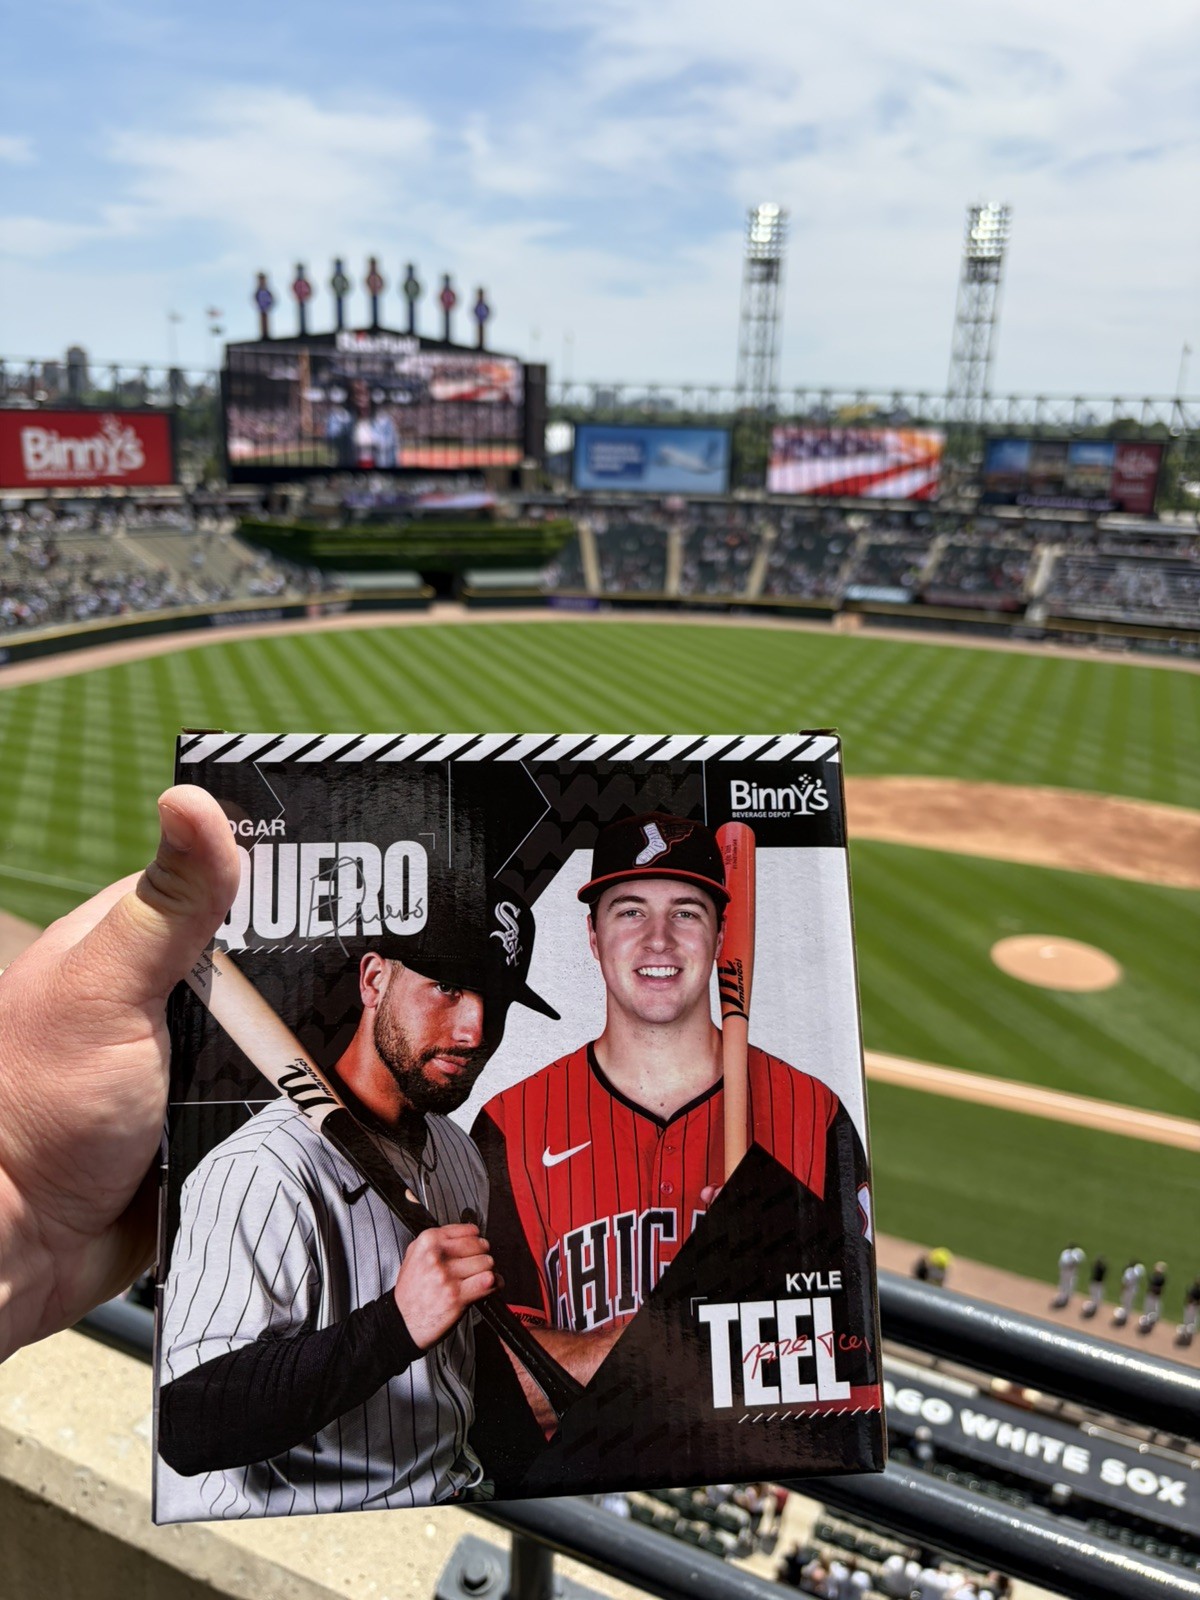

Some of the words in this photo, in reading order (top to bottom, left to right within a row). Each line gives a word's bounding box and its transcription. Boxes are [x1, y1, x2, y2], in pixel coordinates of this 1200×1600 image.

[226, 819, 286, 836] DGAR
[213, 840, 428, 949] QUERO
[734, 957, 745, 1004] marucci
[294, 1058, 334, 1097] marucci
[545, 1207, 706, 1333] CHIC
[786, 1270, 842, 1292] KYLE
[698, 1297, 851, 1408] TEEL
[959, 1408, 1091, 1474] WHITE
[1100, 1458, 1187, 1507] SOX
